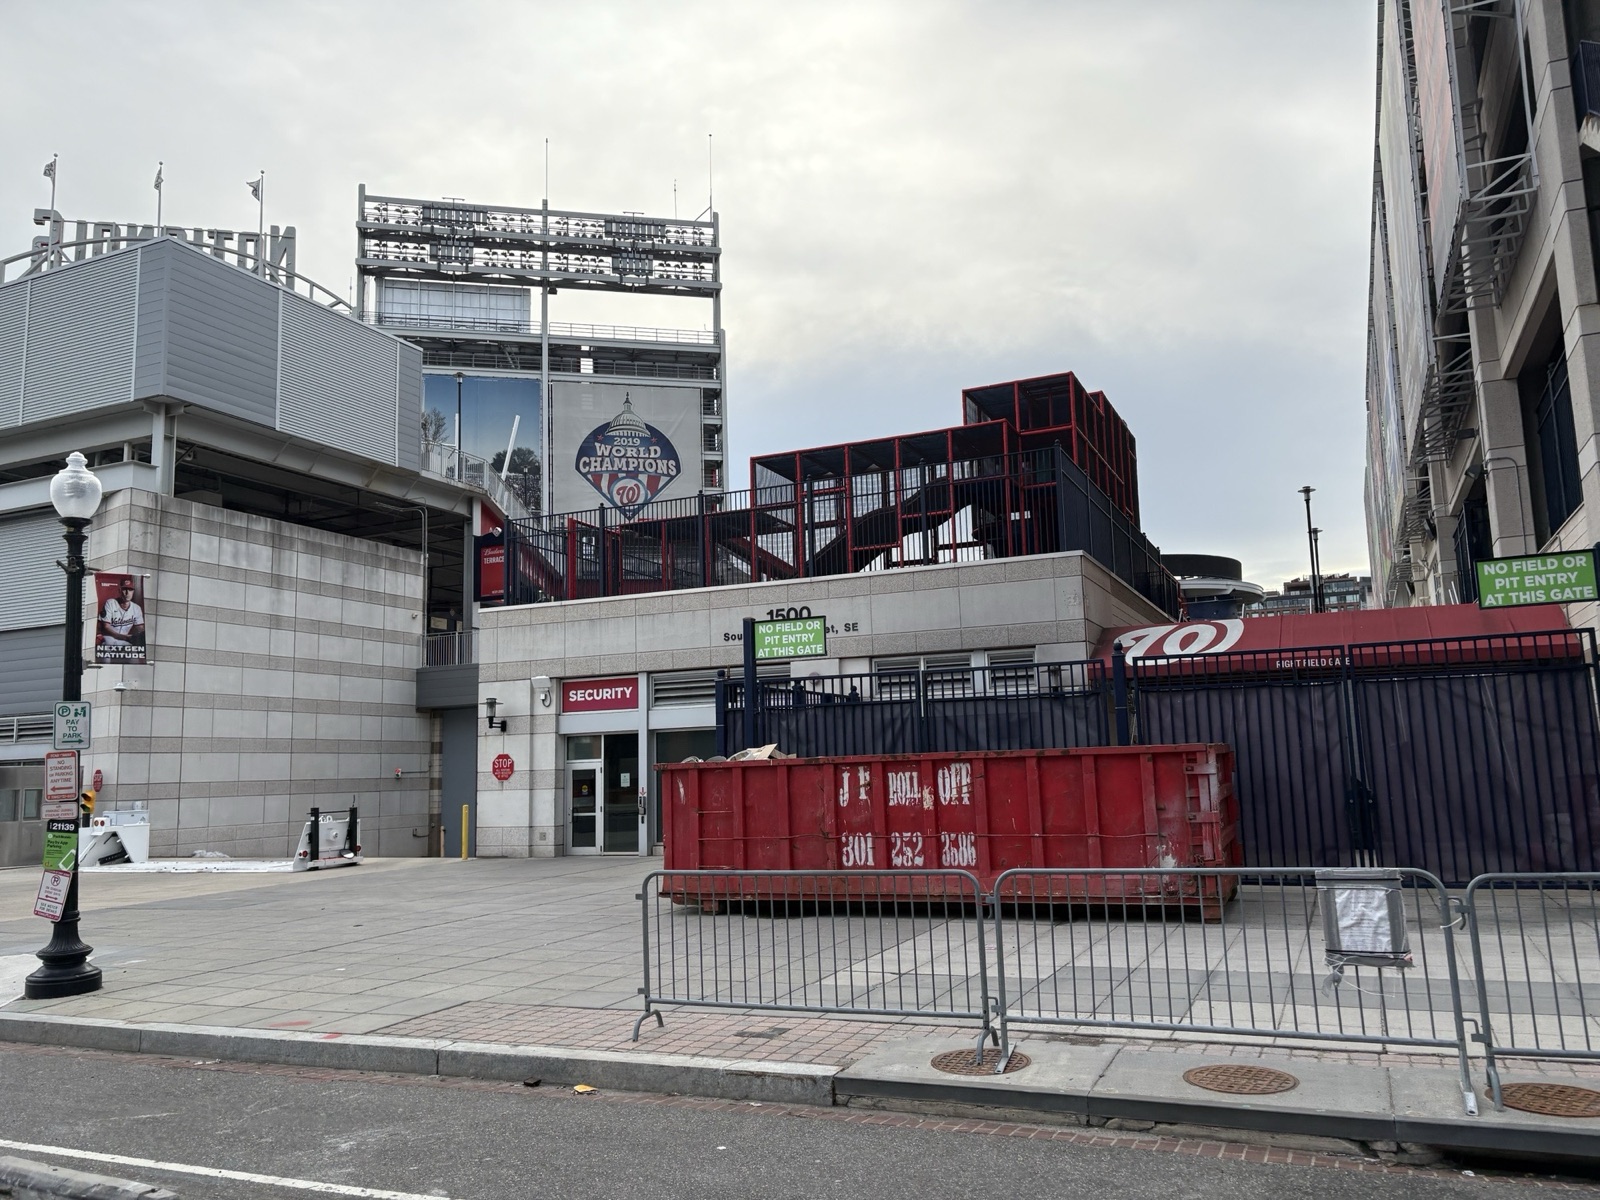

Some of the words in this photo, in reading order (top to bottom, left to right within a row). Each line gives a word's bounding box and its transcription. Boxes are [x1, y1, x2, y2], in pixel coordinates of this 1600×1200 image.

[594, 442, 662, 458] WORLD
[614, 437, 640, 446] 2019
[579, 456, 677, 476] CHAMPIONS
[616, 483, 641, 506] W
[1484, 562, 1508, 576] NO
[1512, 558, 1558, 573] FIELD
[1562, 555, 1587, 568] OR
[1495, 577, 1520, 590] PIT
[1524, 572, 1578, 587] ENTRY
[1485, 593, 1504, 606] AT
[1508, 590, 1546, 604] THIS
[1550, 586, 1594, 600] GATE
[724, 632, 743, 642] Sou
[844, 622, 859, 632] SE
[758, 624, 774, 634] NO
[776, 622, 803, 633] FIELD
[806, 620, 821, 631] OR
[764, 635, 780, 646] PIT
[782, 632, 816, 644] ENTRY
[758, 648, 770, 658] AT
[772, 646, 794, 656] THIS
[798, 644, 823, 655] GATE
[568, 686, 633, 702] SECURITY
[494, 758, 512, 768] STOP
[937, 762, 972, 806] OFF
[52, 822, 75, 831] 21139
[842, 832, 875, 867] 301
[890, 832, 924, 868] 252
